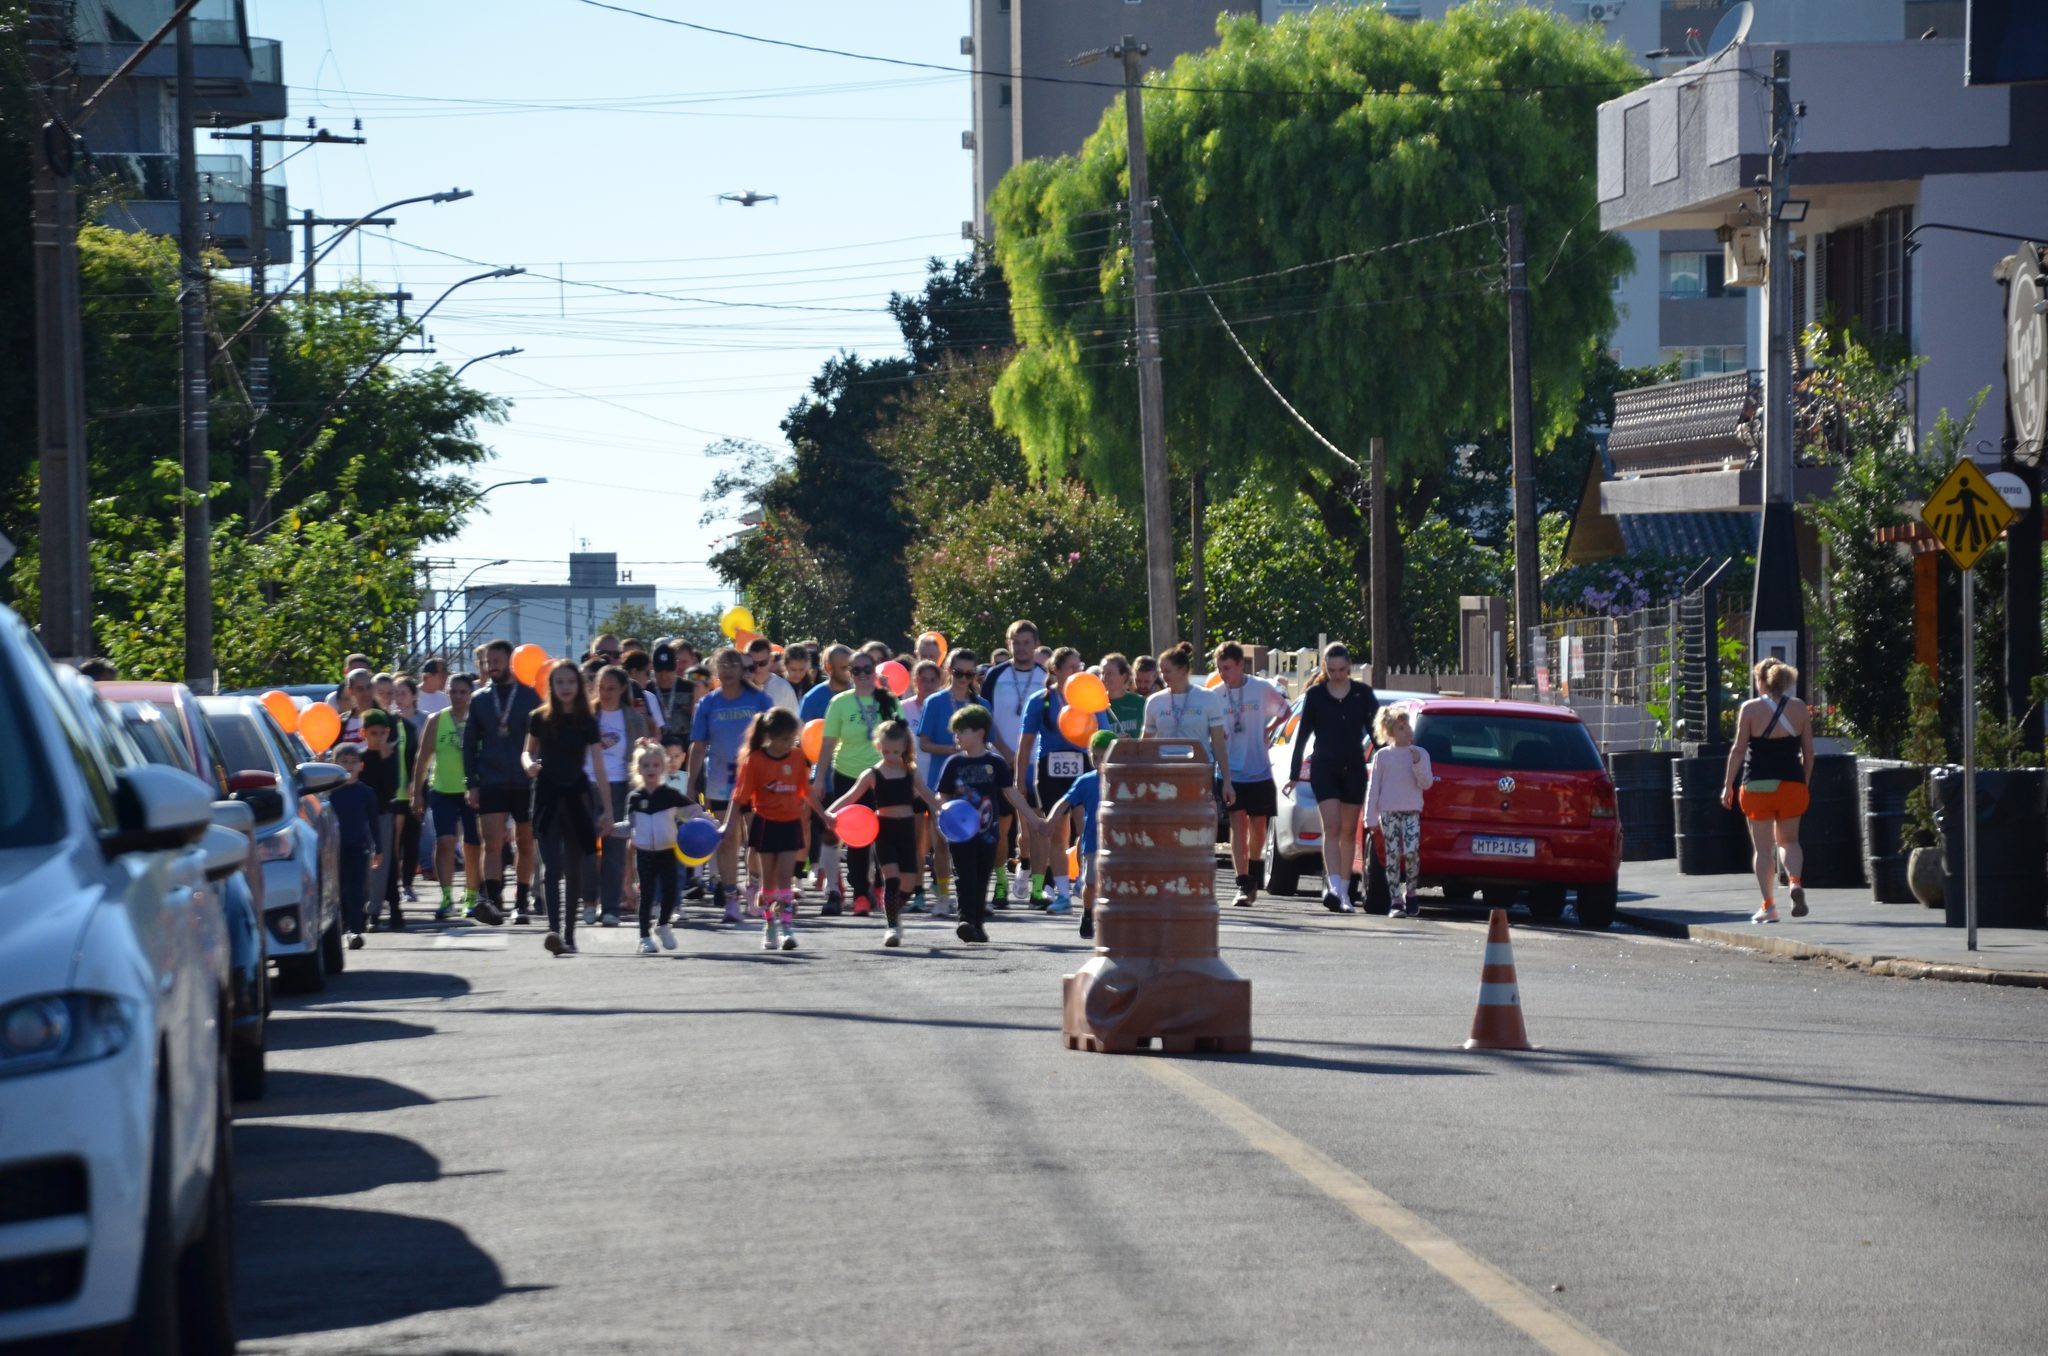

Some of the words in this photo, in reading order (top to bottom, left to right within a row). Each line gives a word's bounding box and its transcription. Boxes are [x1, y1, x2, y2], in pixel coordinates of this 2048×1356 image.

[1995, 486, 2022, 495] rona
[622, 570, 632, 581] H
[1053, 762, 1079, 775] 853
[1477, 840, 1528, 855] MTP1A54
